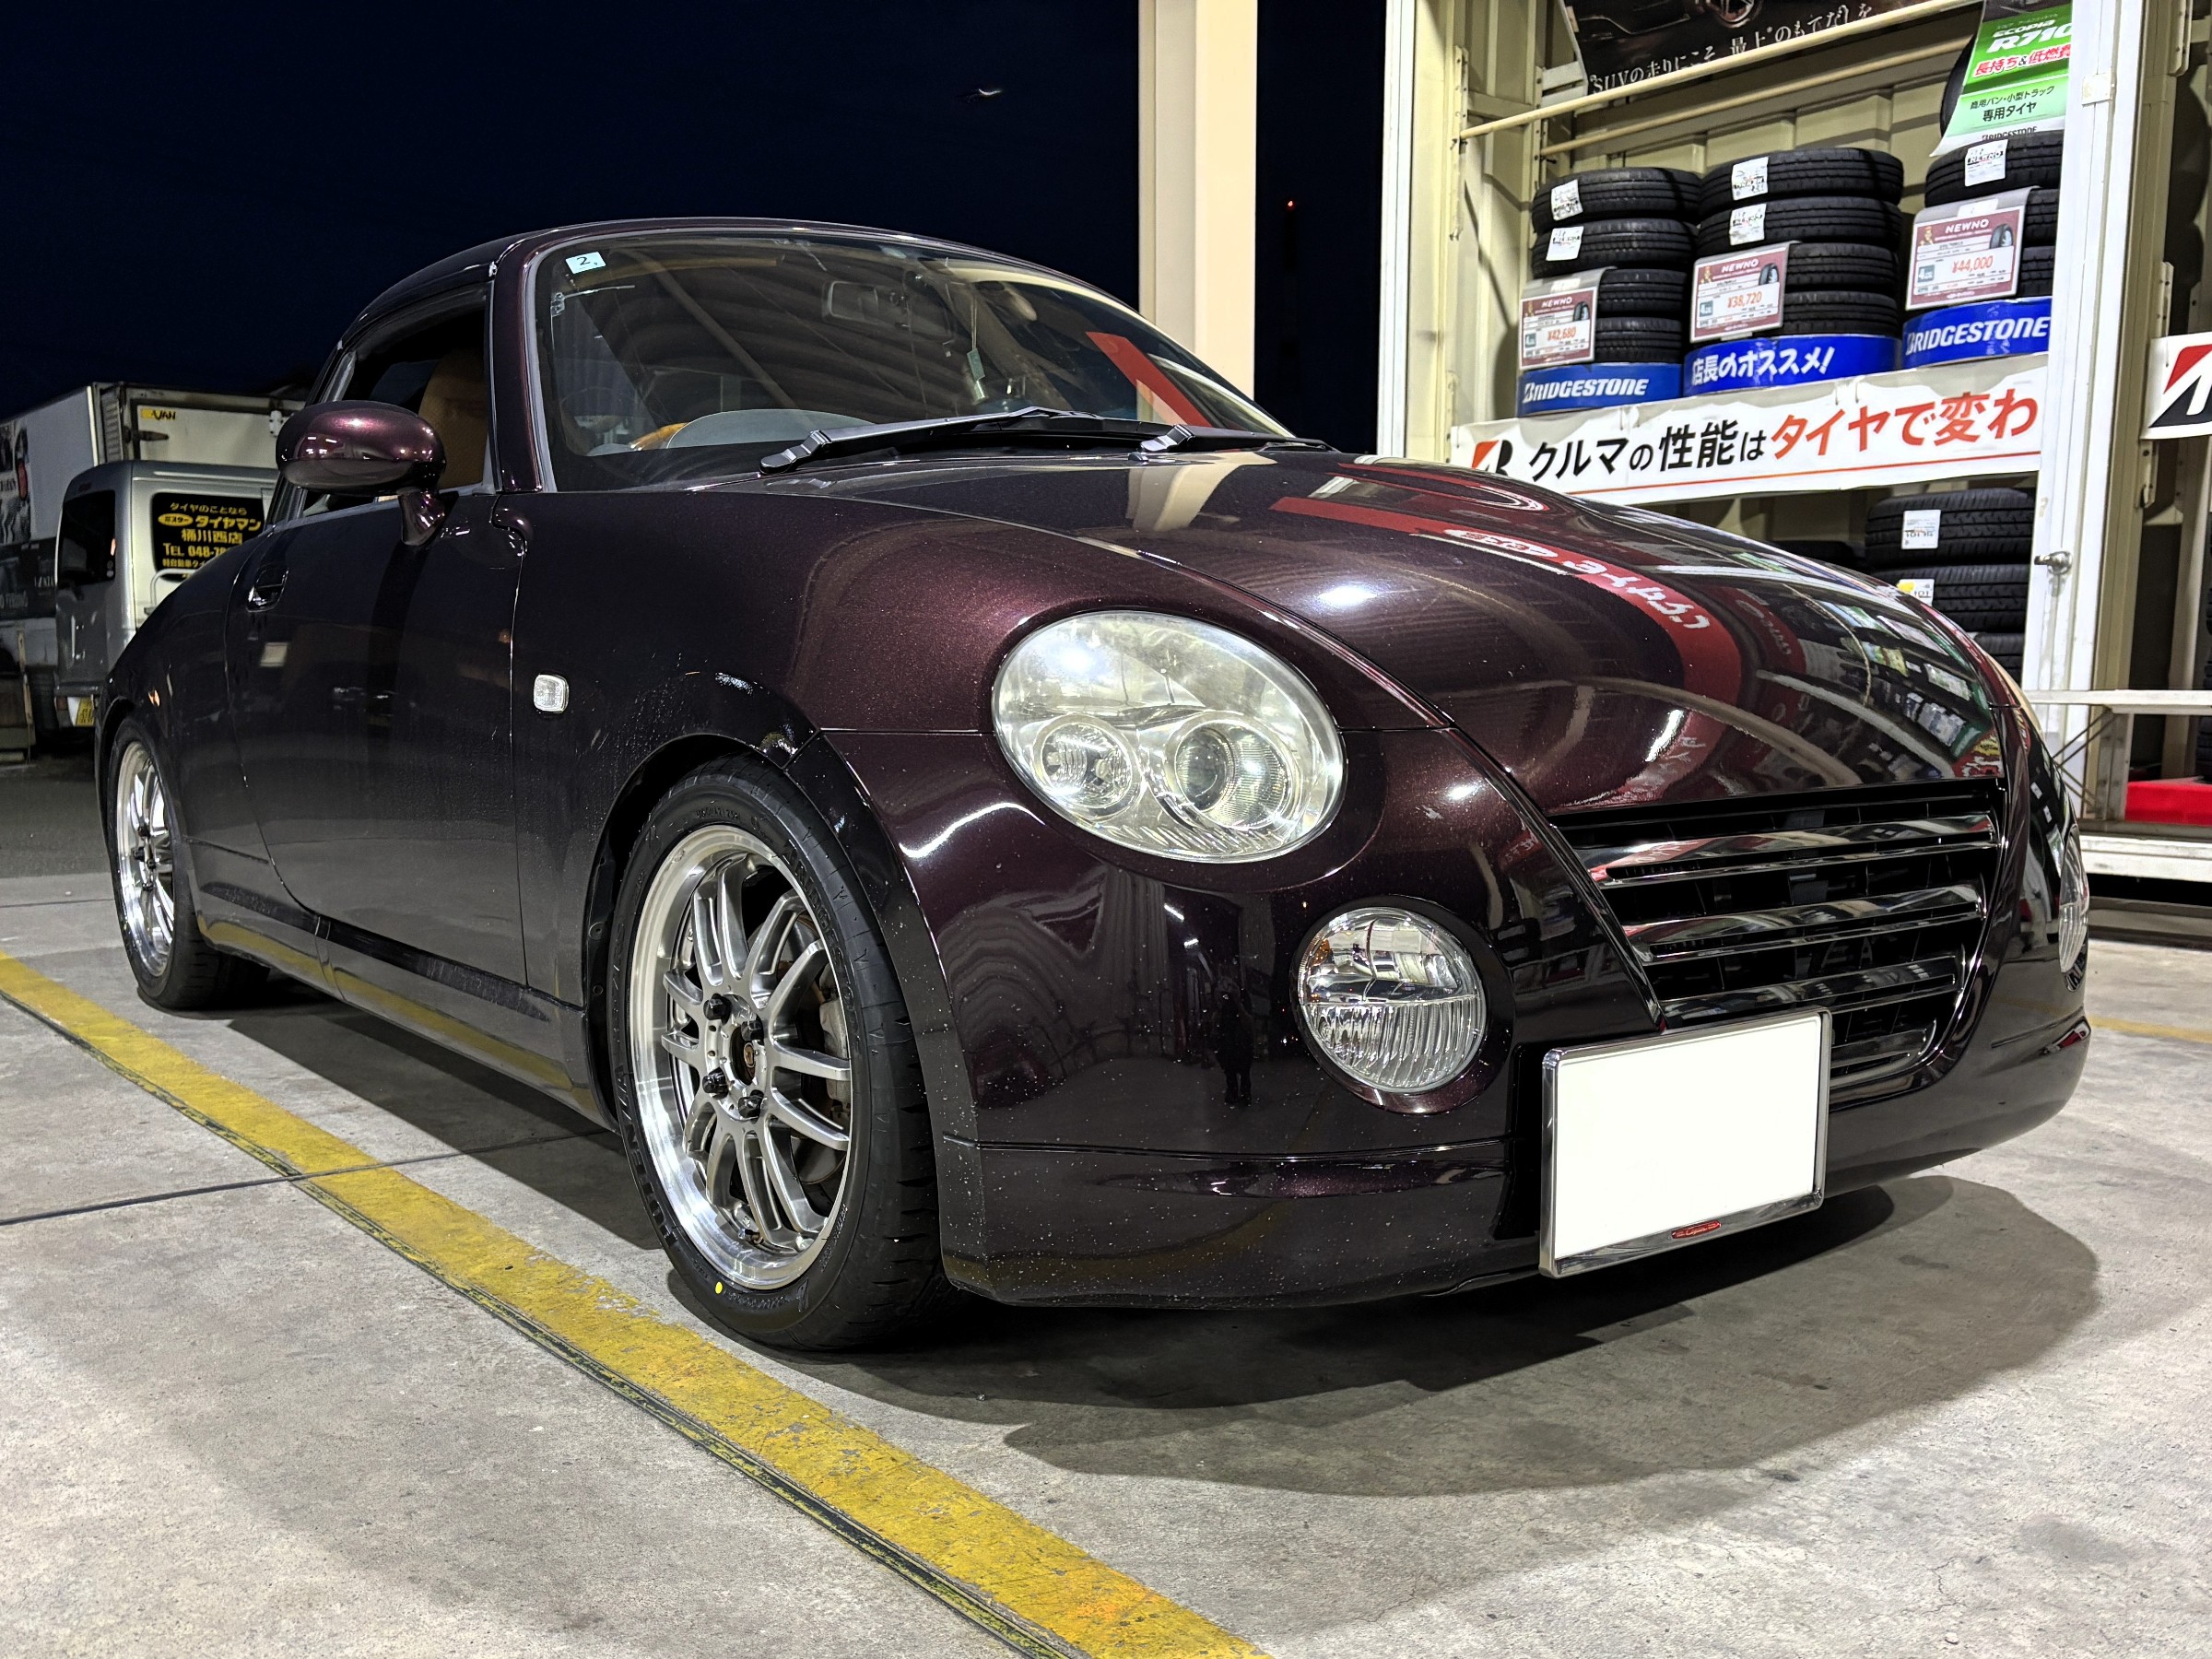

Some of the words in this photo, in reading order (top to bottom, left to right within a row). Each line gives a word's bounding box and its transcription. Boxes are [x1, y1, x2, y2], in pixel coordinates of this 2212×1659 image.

[1983, 100, 2037, 123] 専用タイヤ
[1951, 255, 1994, 274] ¥44,000
[1905, 316, 2052, 356] BRIDGESTONE
[1690, 346, 1836, 386] 店長のオススメ!
[1522, 378, 1650, 404] BRIDGESTONE
[170, 501, 248, 516] タイヤのことなら
[194, 514, 262, 532] タイヤマン
